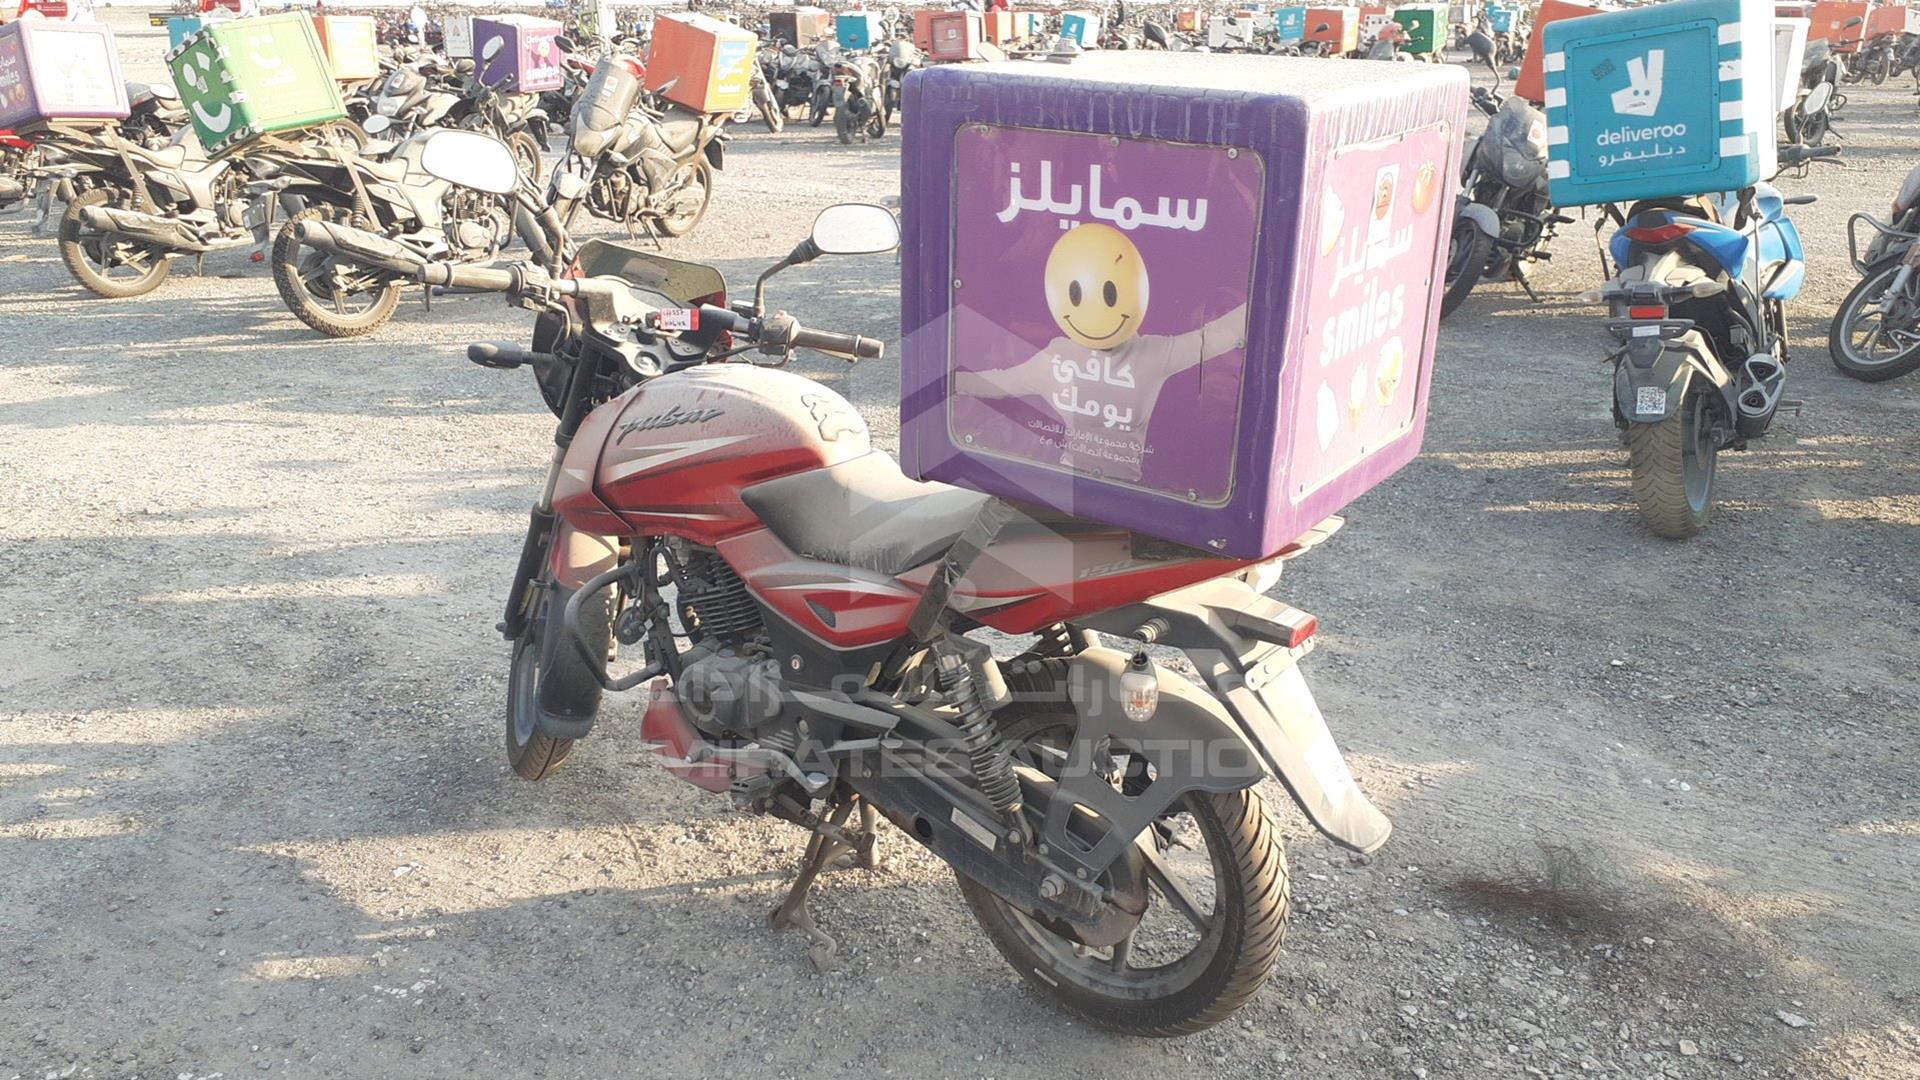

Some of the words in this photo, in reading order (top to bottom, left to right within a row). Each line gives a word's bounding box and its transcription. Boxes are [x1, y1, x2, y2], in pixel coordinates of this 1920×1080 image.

[1596, 123, 1686, 146] deliveroo
[1598, 143, 1686, 168] ديليفرو
[996, 160, 1208, 231] سمايلز
[1320, 277, 1406, 368] smiles
[1051, 351, 1136, 389] كافئ
[1052, 386, 1133, 432] يومك
